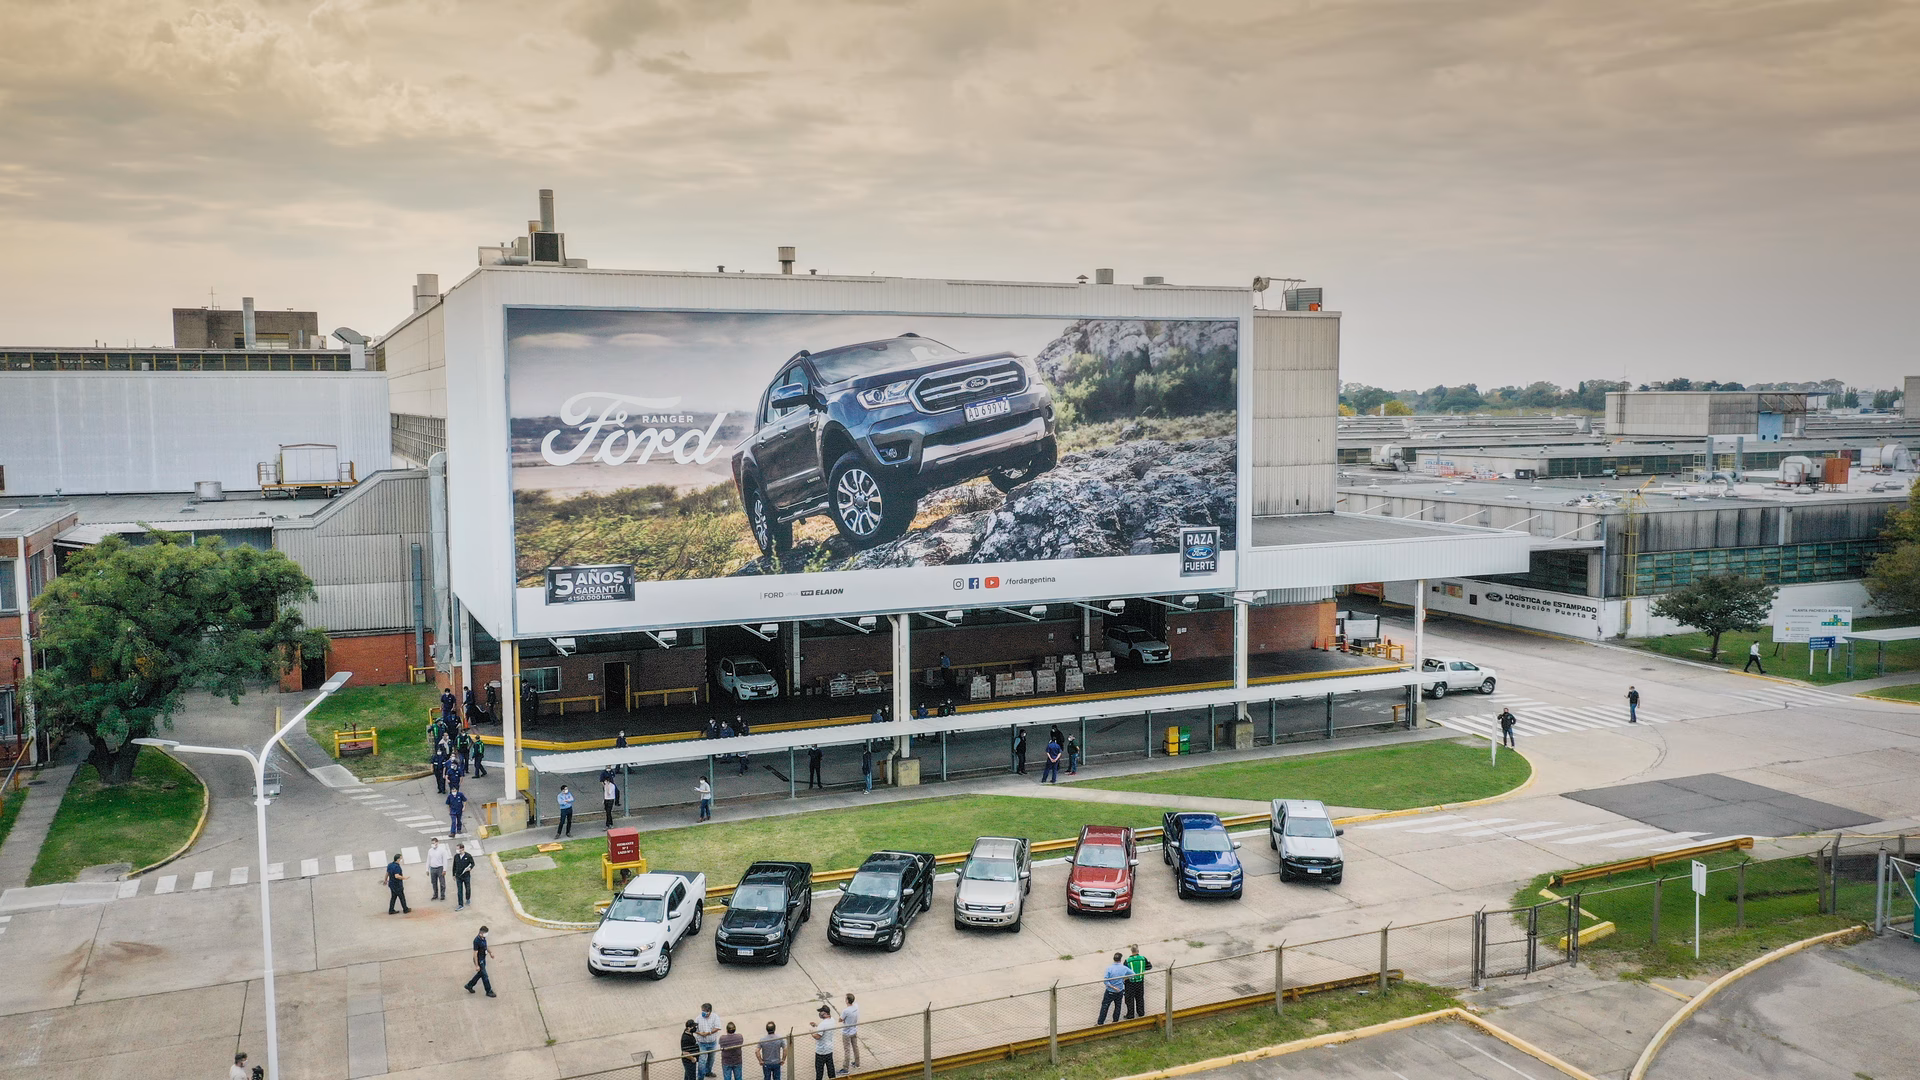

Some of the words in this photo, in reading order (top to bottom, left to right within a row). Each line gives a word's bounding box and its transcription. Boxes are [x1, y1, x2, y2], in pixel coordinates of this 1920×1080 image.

[642, 415, 694, 424] RANGER
[541, 391, 728, 466] Ford
[1187, 533, 1214, 545] RAZA
[1185, 561, 1215, 571] FUERTE
[555, 573, 574, 596] 5
[575, 569, 625, 585] AÑOS
[574, 584, 626, 595] GARANTÍA
[815, 588, 844, 596] ELAION
[1505, 600, 1551, 612] Recepción
[1555, 608, 1586, 618] Puerta
[1553, 601, 1597, 613] ESTAMPADO
